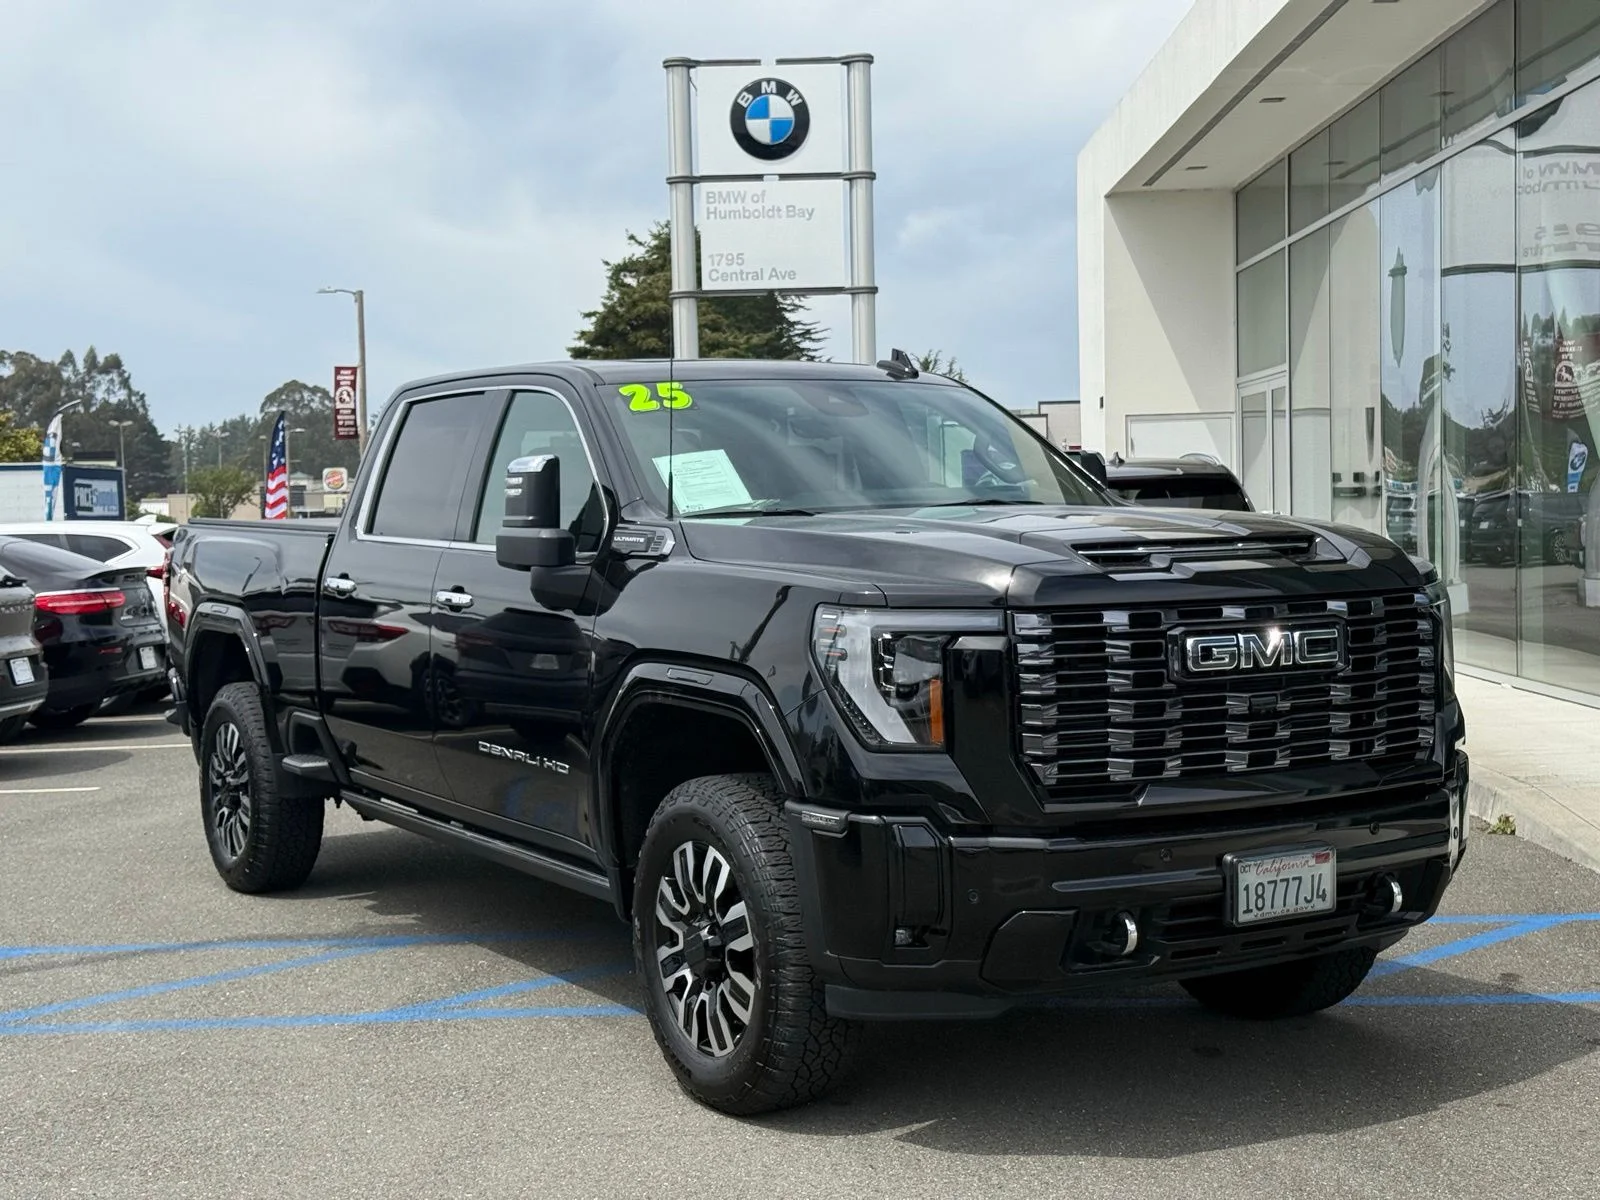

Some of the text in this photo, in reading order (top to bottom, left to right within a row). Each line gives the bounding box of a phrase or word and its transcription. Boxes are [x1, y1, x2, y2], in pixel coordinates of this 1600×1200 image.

[737, 80, 803, 108] BMW
[706, 190, 766, 205] BMW of
[706, 204, 815, 221] Humboldt Bay
[708, 253, 745, 267] 1795
[708, 268, 797, 282] Central Ave
[619, 382, 693, 411] 25
[1186, 629, 1339, 672] GMC
[479, 741, 570, 775] DENALI HD
[1255, 858, 1315, 877] California
[1242, 873, 1327, 914] 18777J4
